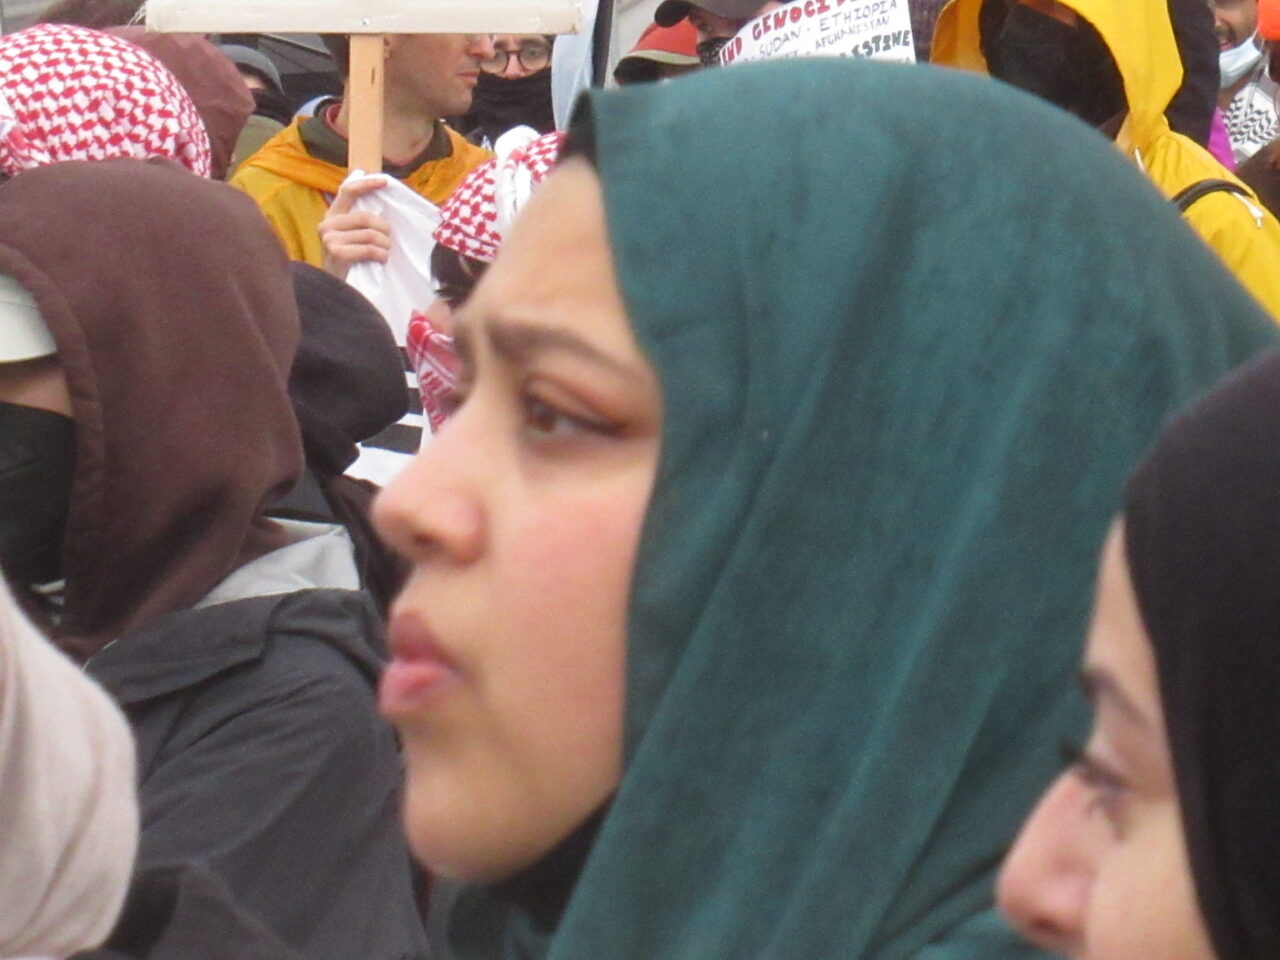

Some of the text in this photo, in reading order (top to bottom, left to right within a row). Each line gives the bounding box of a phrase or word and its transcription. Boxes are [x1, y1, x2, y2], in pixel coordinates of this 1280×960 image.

[759, 25, 802, 57] SUDAN
[815, 16, 890, 52] AFGHANISTAN
[721, 36, 743, 66] END
